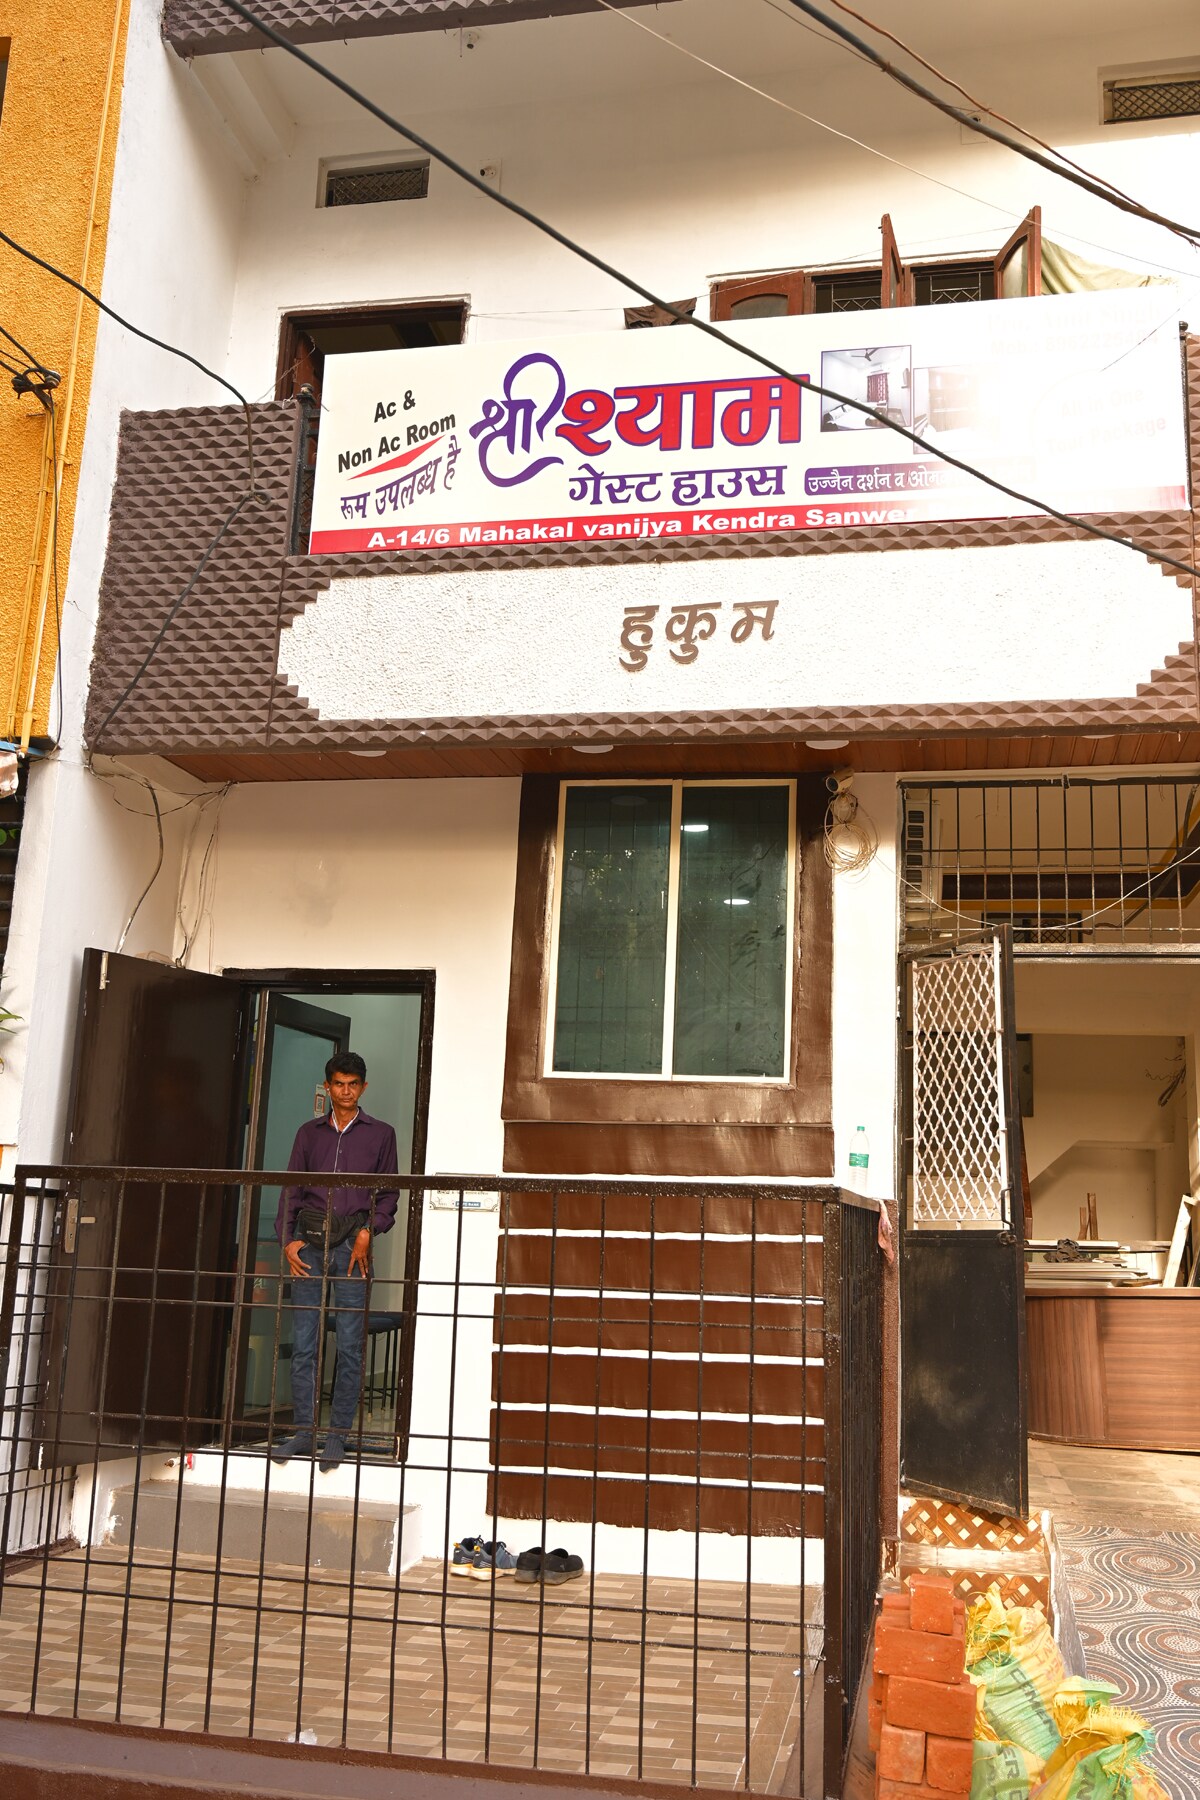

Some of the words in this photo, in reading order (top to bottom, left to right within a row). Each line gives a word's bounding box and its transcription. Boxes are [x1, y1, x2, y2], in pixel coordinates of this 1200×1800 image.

[374, 401, 397, 423] Ac
[403, 390, 416, 410] &
[469, 353, 565, 487] श्री
[555, 374, 810, 456] श्याम
[338, 447, 372, 473] Non
[378, 436, 401, 458] Ac
[406, 414, 456, 446] Room
[1089, 417, 1166, 446] Package
[340, 491, 371, 519] रूम
[376, 456, 443, 515] उपलब्ध
[444, 434, 462, 490] है
[569, 463, 663, 505] गेस्ट
[671, 465, 788, 507] हाउस
[808, 469, 854, 492] उज्जैन
[857, 467, 892, 491] दर्शन
[367, 528, 450, 548] A-14/6
[459, 522, 574, 543] Mahakal
[584, 517, 682, 541] vanijya
[692, 512, 796, 532] Kendra
[805, 506, 917, 526] Sanwer
[619, 600, 779, 672] हुकुम
